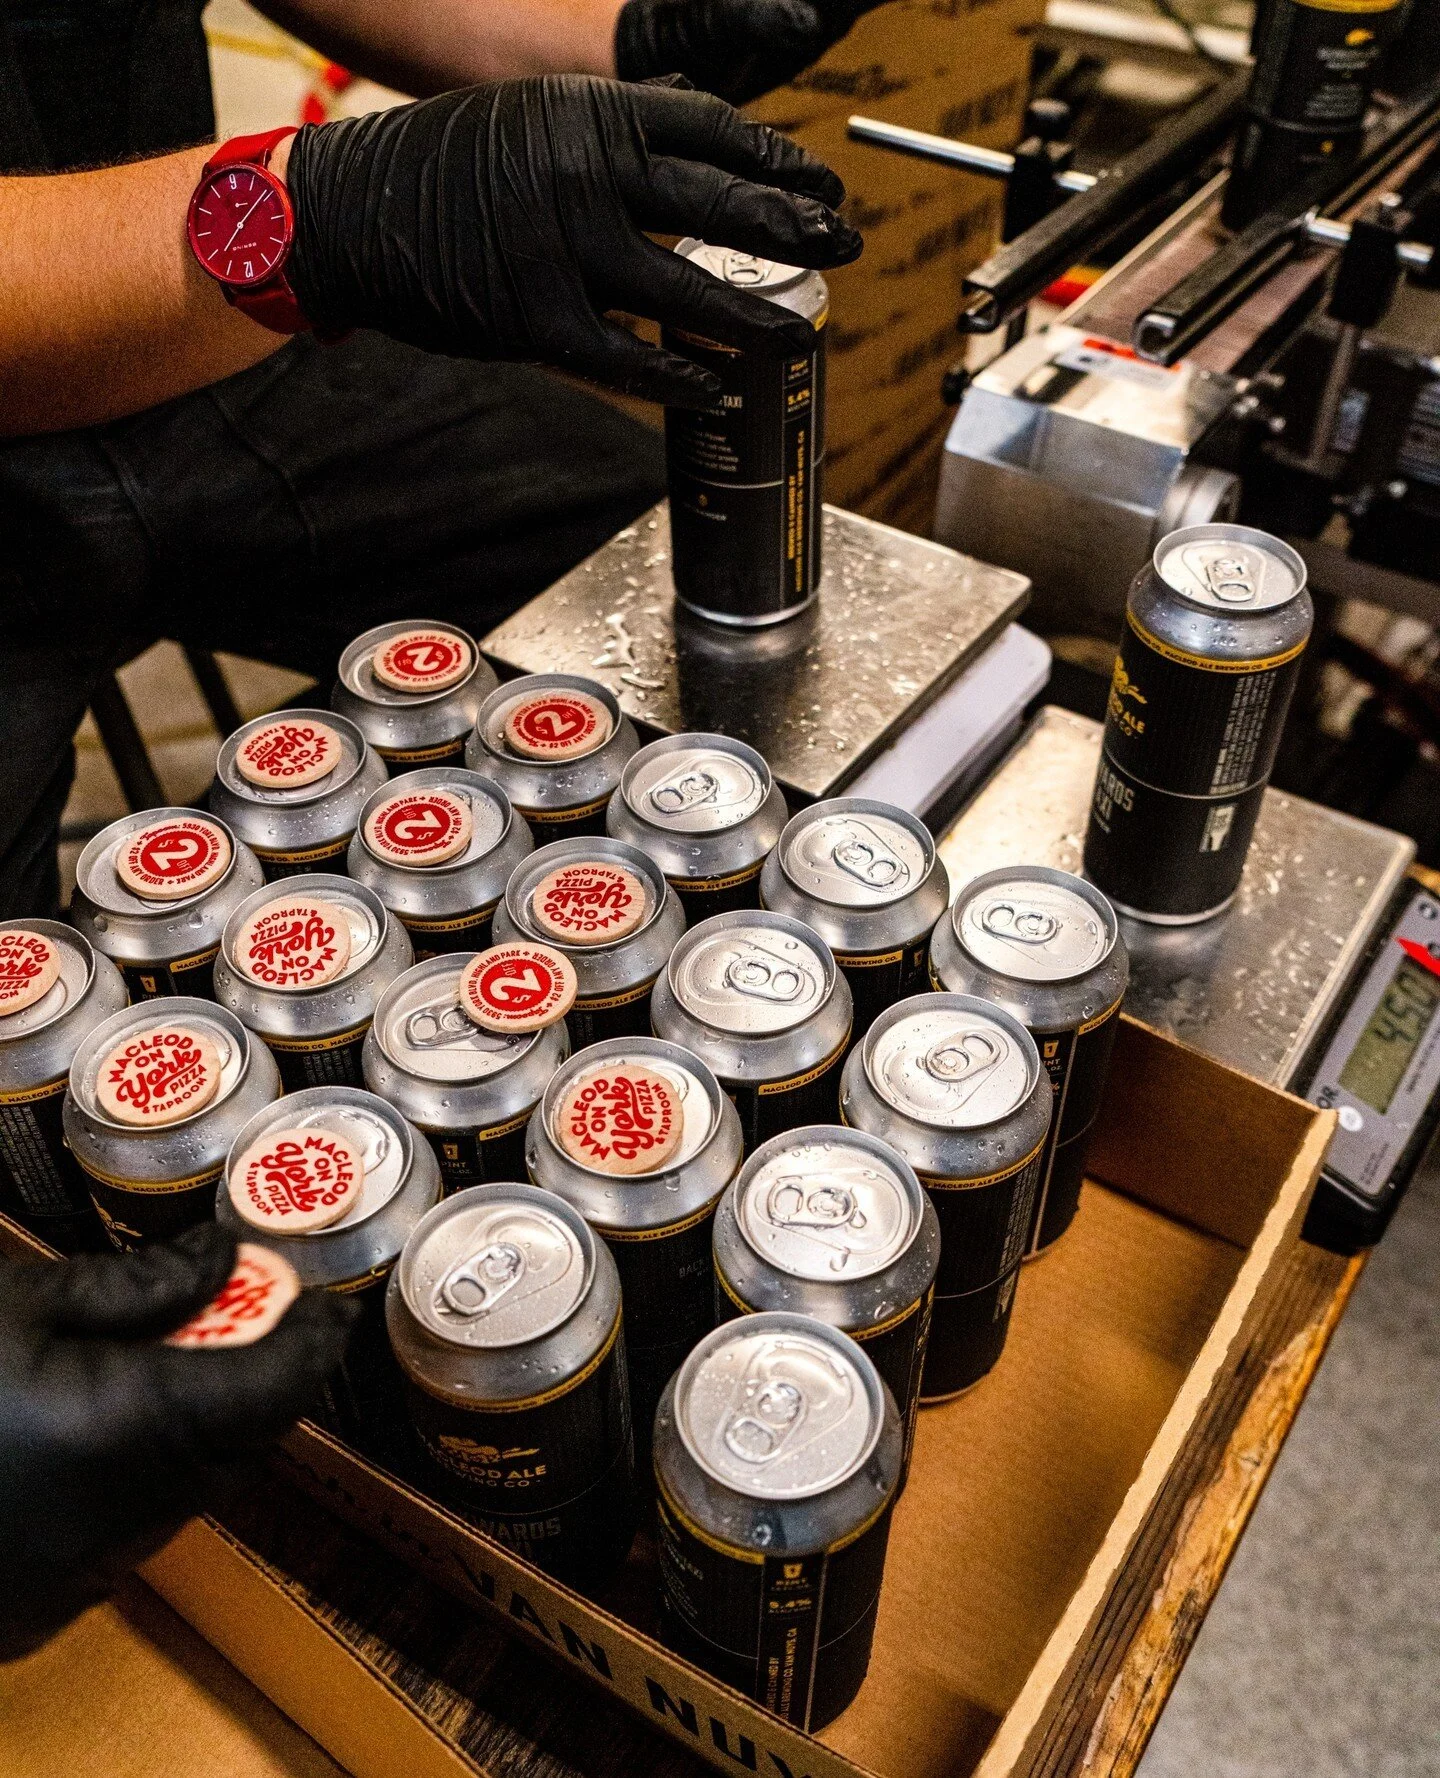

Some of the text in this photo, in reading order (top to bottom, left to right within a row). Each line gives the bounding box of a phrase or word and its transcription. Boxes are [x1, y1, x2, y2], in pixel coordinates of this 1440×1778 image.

[723, 395, 743, 409] TAXI
[1164, 650, 1199, 666] MACLEOD
[1199, 662, 1213, 671] ALE
[1123, 711, 1146, 735] ALE
[247, 741, 272, 762] PIZZA
[269, 736, 328, 776] MACLEOD
[288, 750, 311, 765] ON
[400, 796, 418, 805] PARK
[428, 796, 452, 809] ORDER
[182, 822, 200, 831] 5930
[293, 851, 329, 862] MACLEOD
[130, 865, 144, 876] ANY
[140, 874, 165, 885] ORDER
[176, 875, 196, 885] PARK
[556, 877, 593, 888] PIZZA
[563, 868, 617, 882] TAPROOM
[254, 908, 309, 930] TAPROOM
[544, 903, 627, 932] MACLEOD
[570, 907, 599, 920] ON
[250, 922, 288, 944] PIZZA
[0, 935, 50, 963] CLEOD
[501, 950, 521, 959] PARK
[177, 954, 214, 969] MACLEOD
[252, 947, 337, 985] MACLEOD
[281, 955, 309, 970] ON
[471, 954, 501, 978] HIGHLAND
[885, 955, 898, 963] CO.
[501, 962, 517, 976] OFF
[532, 952, 564, 1001] $2 OFF ANY ORDER
[0, 979, 30, 990] IZZA
[470, 996, 485, 1010] YORK
[615, 997, 628, 1007] ALE
[483, 1008, 503, 1020] 5930
[331, 1030, 367, 1047] MACLEO
[107, 1033, 194, 1084] MACLEOD
[135, 1048, 165, 1068] ON
[116, 1049, 202, 1108] York
[169, 1064, 207, 1094] PIZZA
[763, 1074, 816, 1093] MACLEOD ALE
[8, 1091, 49, 1103] MACLEOD
[153, 1077, 207, 1113] TAPROOM
[635, 1079, 657, 1115] PIZZA
[571, 1078, 610, 1160] MACLEOD
[591, 1106, 607, 1132] ON
[651, 1083, 672, 1137] TAPROOM
[486, 1120, 524, 1137] MACLEOD
[304, 1136, 353, 1206] MACLEOD
[314, 1157, 333, 1182] ON
[178, 1182, 192, 1190] ALE
[978, 1179, 992, 1187] ALE
[246, 1170, 273, 1216] TAPROOM
[264, 1185, 293, 1215] PIZZA
[642, 1232, 658, 1240] ALE
[660, 1216, 699, 1237] BREWING
[507, 1464, 549, 1481] ALE
[787, 1627, 798, 1637] CA
